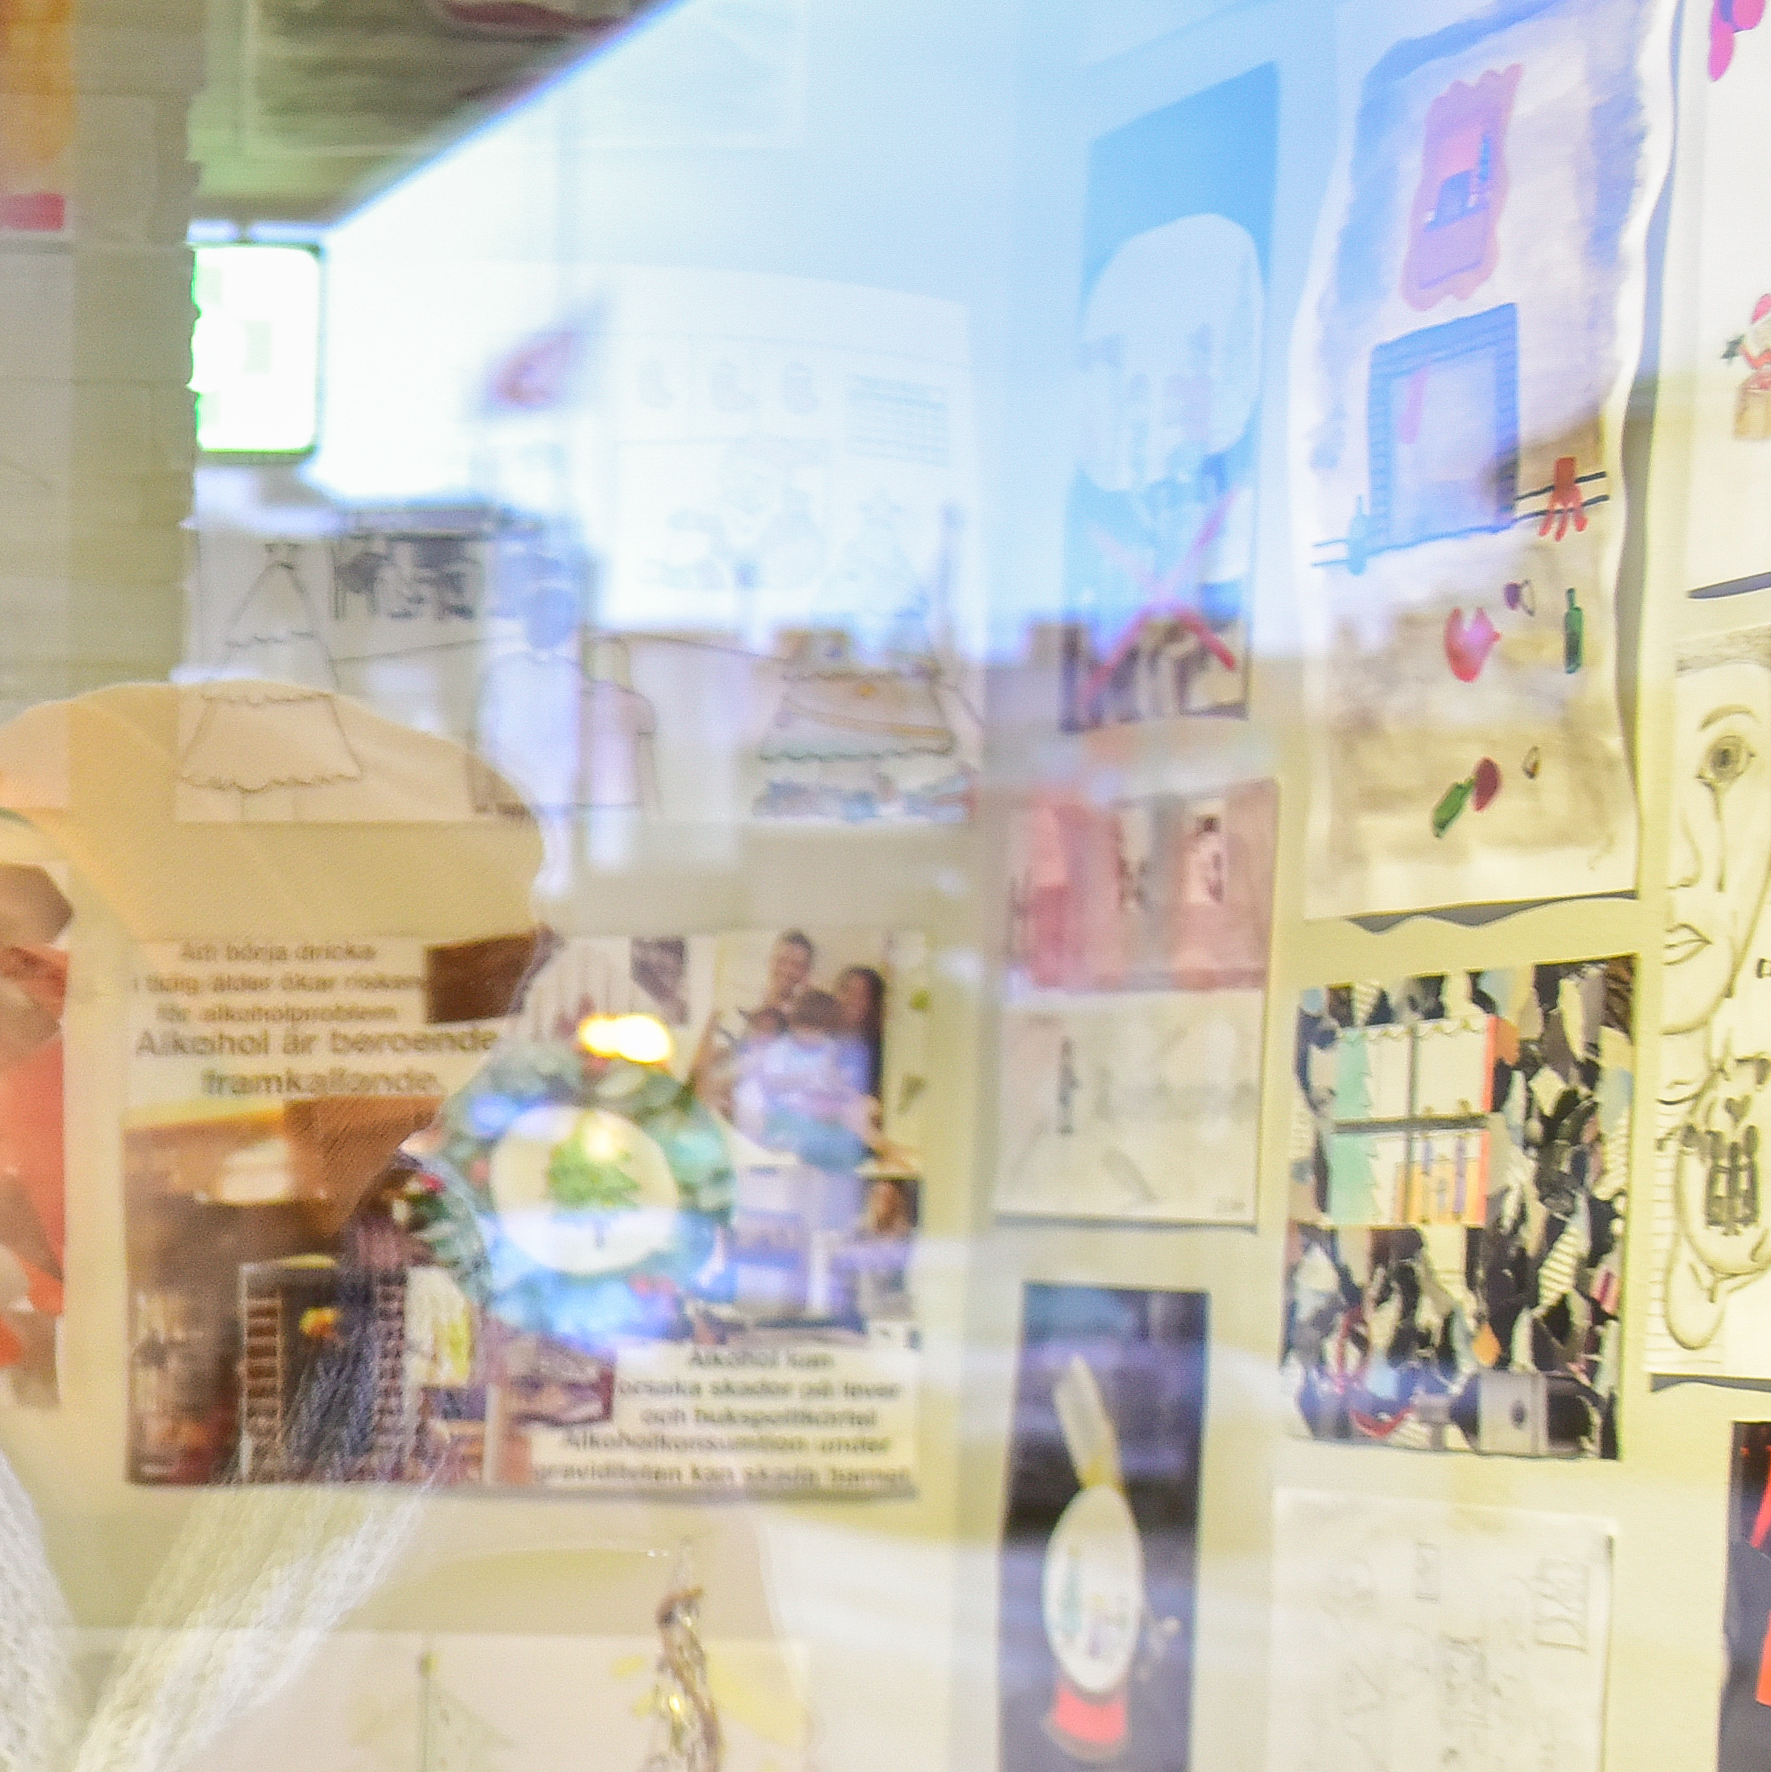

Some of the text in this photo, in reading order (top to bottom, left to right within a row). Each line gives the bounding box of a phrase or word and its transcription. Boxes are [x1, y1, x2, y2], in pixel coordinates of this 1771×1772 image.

[136, 1028, 497, 1057] Alkohol är beroende
